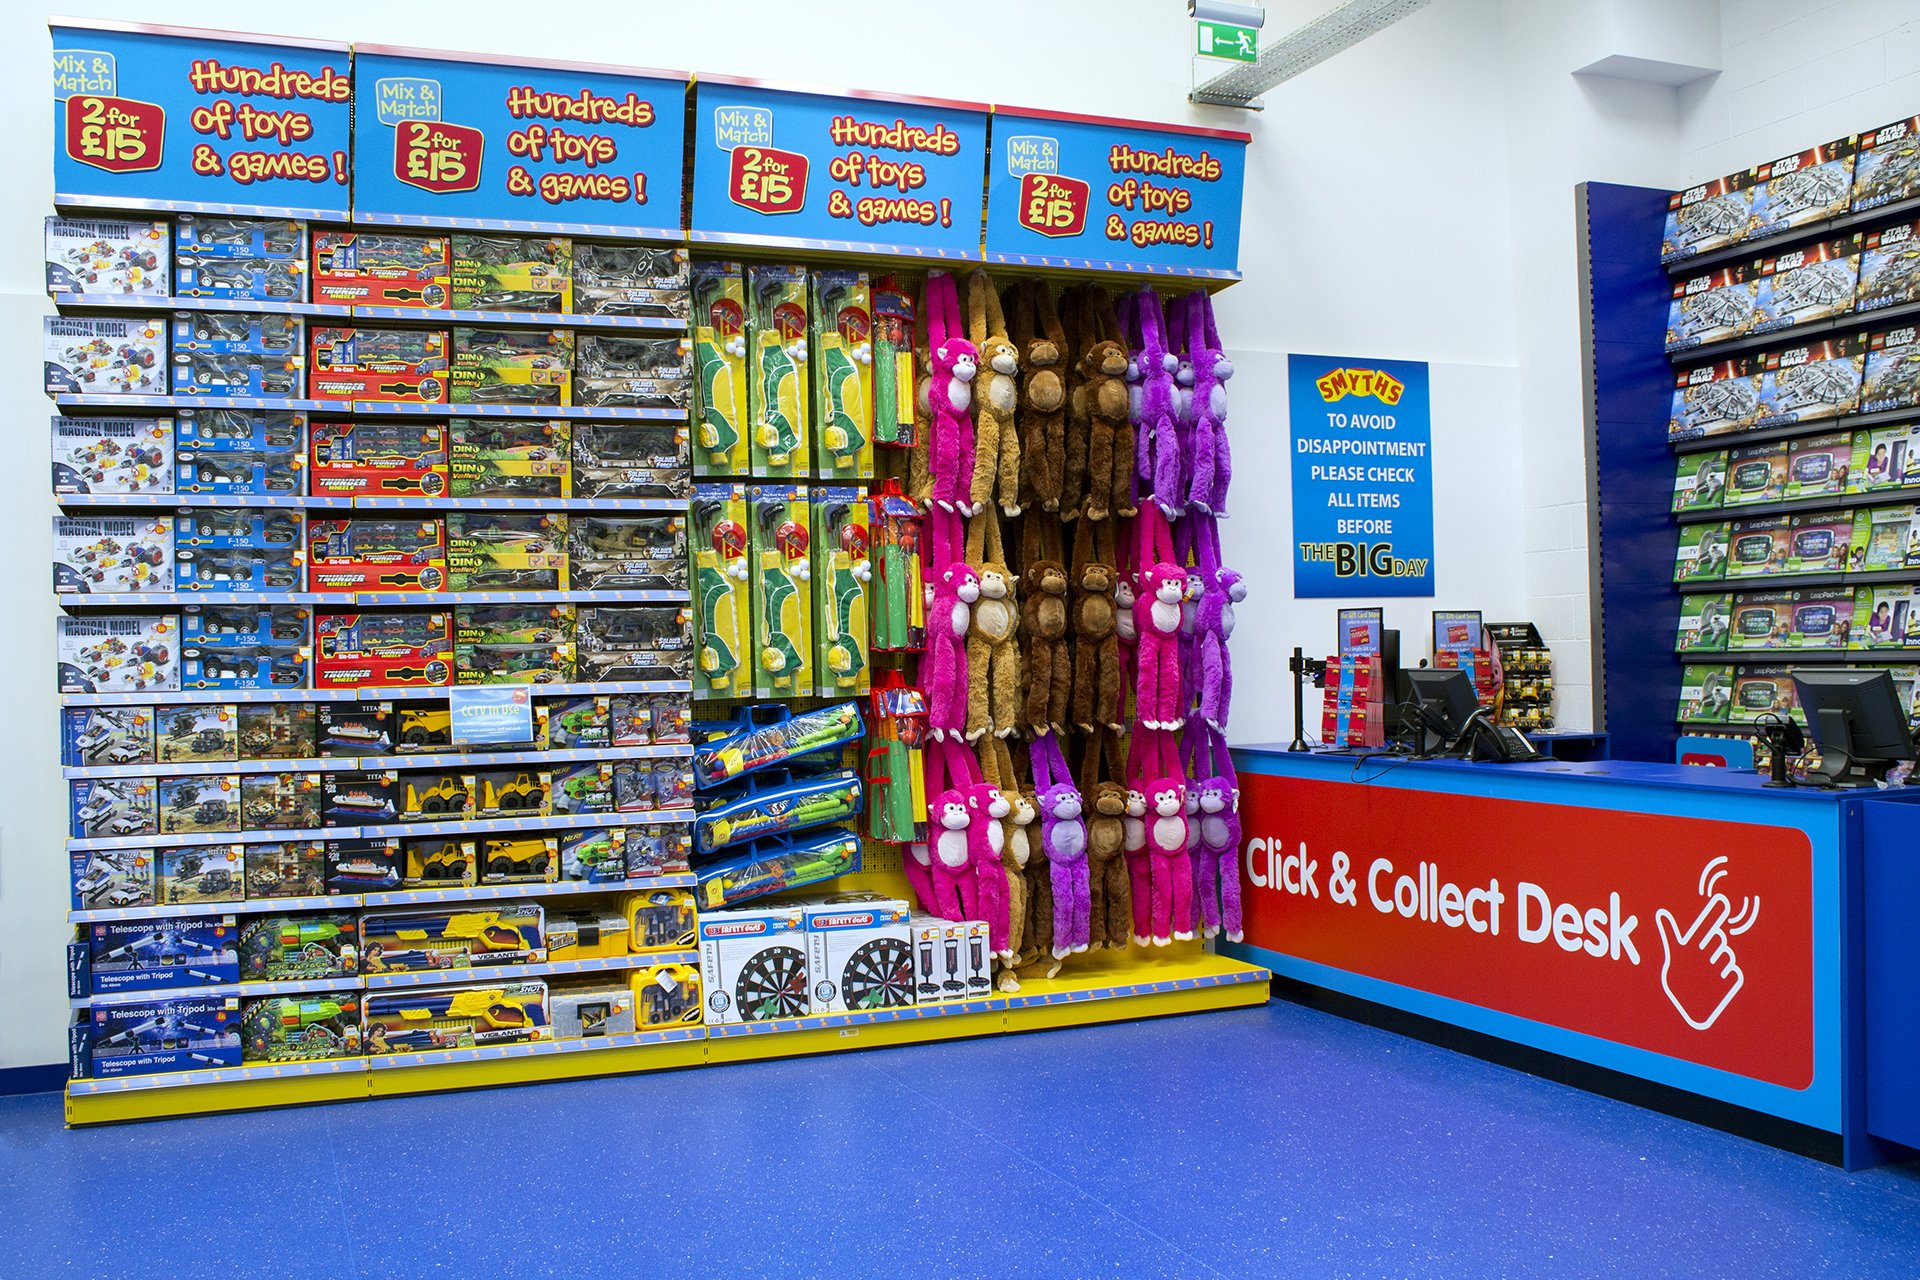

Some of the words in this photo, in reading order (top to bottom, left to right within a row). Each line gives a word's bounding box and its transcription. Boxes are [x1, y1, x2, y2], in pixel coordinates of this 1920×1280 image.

[53, 56, 84, 74] Mix
[93, 57, 109, 74] &
[53, 74, 111, 91] Match
[191, 60, 350, 98] Hundreds
[382, 83, 415, 100] Mix
[420, 85, 434, 99] &
[381, 101, 437, 117] Match
[509, 87, 652, 124] Hundreds
[82, 98, 105, 125] 2
[106, 108, 139, 128] for
[721, 110, 749, 127] Mix
[753, 114, 767, 127] &
[193, 102, 231, 136] of
[238, 105, 310, 142] toys
[719, 126, 769, 143] Match
[831, 117, 958, 153] Hundreds
[1880, 123, 1907, 135] STAR
[409, 123, 430, 147] 2
[431, 132, 461, 151] for
[1876, 132, 1904, 145] WARS
[509, 125, 546, 160] of
[549, 128, 615, 166] toys
[1013, 141, 1038, 155] Mix
[1042, 143, 1054, 156] &
[194, 146, 219, 172] &
[230, 153, 327, 180] games
[335, 153, 346, 181] !
[743, 150, 761, 172] 2
[763, 158, 789, 175] for
[1011, 156, 1055, 170] Match
[1109, 146, 1221, 178] Hundreds
[1775, 155, 1800, 167] STAR
[831, 153, 862, 183] of
[869, 156, 924, 190] toys
[1772, 164, 1799, 177] WARS
[508, 167, 533, 195] &
[541, 175, 629, 203] games
[634, 174, 647, 204] !
[1032, 176, 1048, 197] 2
[1049, 184, 1072, 200] for
[1686, 185, 1707, 197] STAR
[1109, 179, 1138, 209] of
[1141, 181, 1190, 214] toys
[1682, 194, 1705, 206] WARS
[830, 191, 850, 216] &
[858, 199, 935, 225] games
[941, 200, 951, 225] !
[54, 222, 96, 239] MAGICAL
[99, 225, 130, 240] MODEL
[1107, 215, 1125, 240] &
[1131, 221, 1199, 246] games
[1205, 221, 1213, 247] !
[1885, 224, 1911, 236] STAR
[1881, 233, 1908, 245] WARS
[1781, 251, 1804, 262] STAR
[1776, 261, 1802, 272] WARS
[453, 277, 486, 287] DINO
[1689, 276, 1711, 286] STAR
[320, 286, 369, 295] THUNDER
[453, 286, 481, 294] Valley
[1686, 284, 1709, 295] WARS
[51, 321, 94, 337] MAGICAL
[96, 322, 128, 338] MODEL
[1891, 328, 1916, 338] STAR
[1886, 336, 1913, 347] WARS
[1784, 348, 1809, 358] STAR
[1781, 357, 1807, 367] WARS
[453, 370, 486, 380] DINO
[1693, 366, 1715, 376] STAR
[317, 382, 365, 390] THUNDER
[453, 379, 481, 387] Valley
[1690, 375, 1712, 385] WARS
[1319, 372, 1402, 402] SMYTHS
[1327, 413, 1347, 428] TO
[1350, 414, 1396, 430] AVOID
[59, 421, 102, 437] MAGICAL
[104, 422, 136, 437] MODEL
[1298, 439, 1426, 456] DISAPPOINTMENT
[452, 464, 486, 473] DINO
[1311, 466, 1364, 481] PLEASE
[1368, 467, 1415, 482] CHECK
[319, 478, 368, 486] THUNDER
[452, 472, 481, 480] Valley
[1328, 493, 1354, 507] ALL
[1357, 493, 1400, 508] ITEMS
[59, 521, 103, 537] MAGICAL
[104, 521, 136, 536] MODEL
[1337, 519, 1392, 534] BEFORE
[450, 557, 483, 566] DINO
[450, 566, 479, 574] Valley
[316, 574, 365, 582] THUNDER
[65, 621, 108, 636] MAGICAL
[110, 621, 142, 635] MODEL
[323, 670, 371, 678] THUNDER
[458, 671, 485, 679] DINO
[462, 705, 487, 716] CCTV
[502, 704, 520, 715] Use
[552, 766, 571, 775] NERF
[563, 832, 584, 843] NERF
[1246, 836, 1319, 899] Click
[1328, 850, 1357, 907] &
[1368, 857, 1505, 936] Collect
[1518, 881, 1641, 965] Desk
[111, 924, 154, 934] Telescope
[156, 922, 173, 931] with
[176, 921, 203, 930] Tripod
[101, 975, 135, 983] Telescope
[520, 985, 542, 993] SHOT
[111, 1009, 155, 1019] Telescope
[157, 1007, 175, 1016] with
[178, 1005, 205, 1015] Tripod
[482, 1030, 522, 1038] VIGILANTE
[102, 1060, 136, 1068] Telescope
[154, 1056, 175, 1064] Tripod
